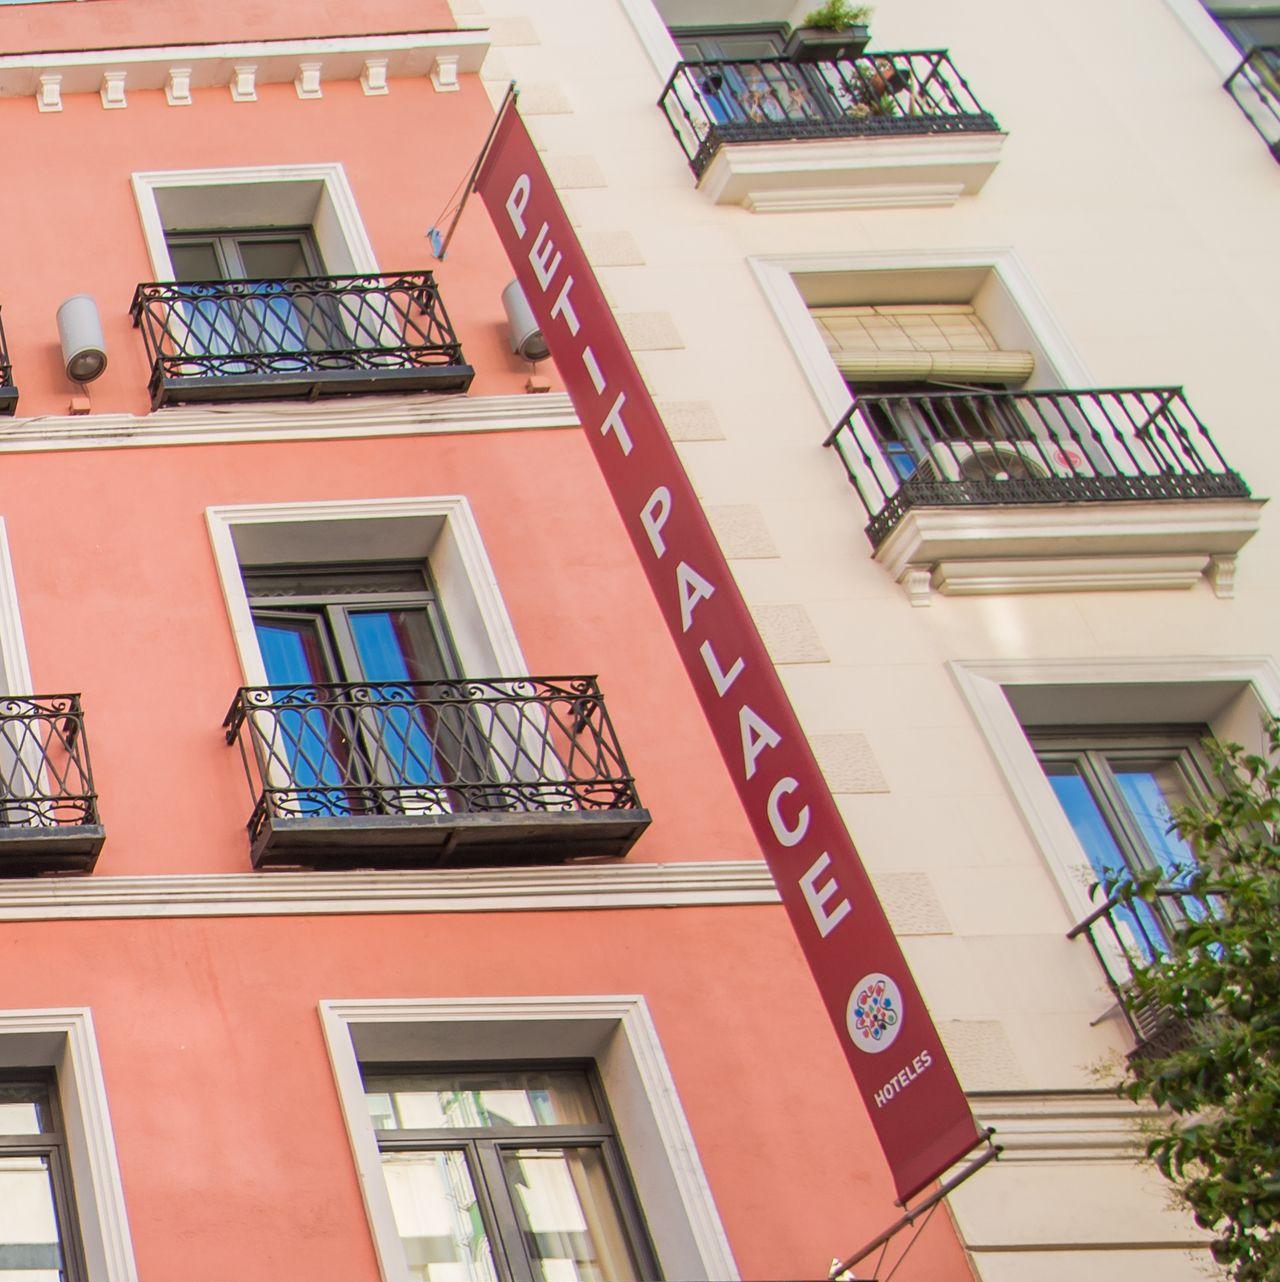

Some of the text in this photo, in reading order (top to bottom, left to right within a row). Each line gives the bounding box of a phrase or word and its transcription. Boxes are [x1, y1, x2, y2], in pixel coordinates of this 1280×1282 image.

[505, 173, 852, 939] PETIT PALACE
[873, 1049, 933, 1109] HOTELES
